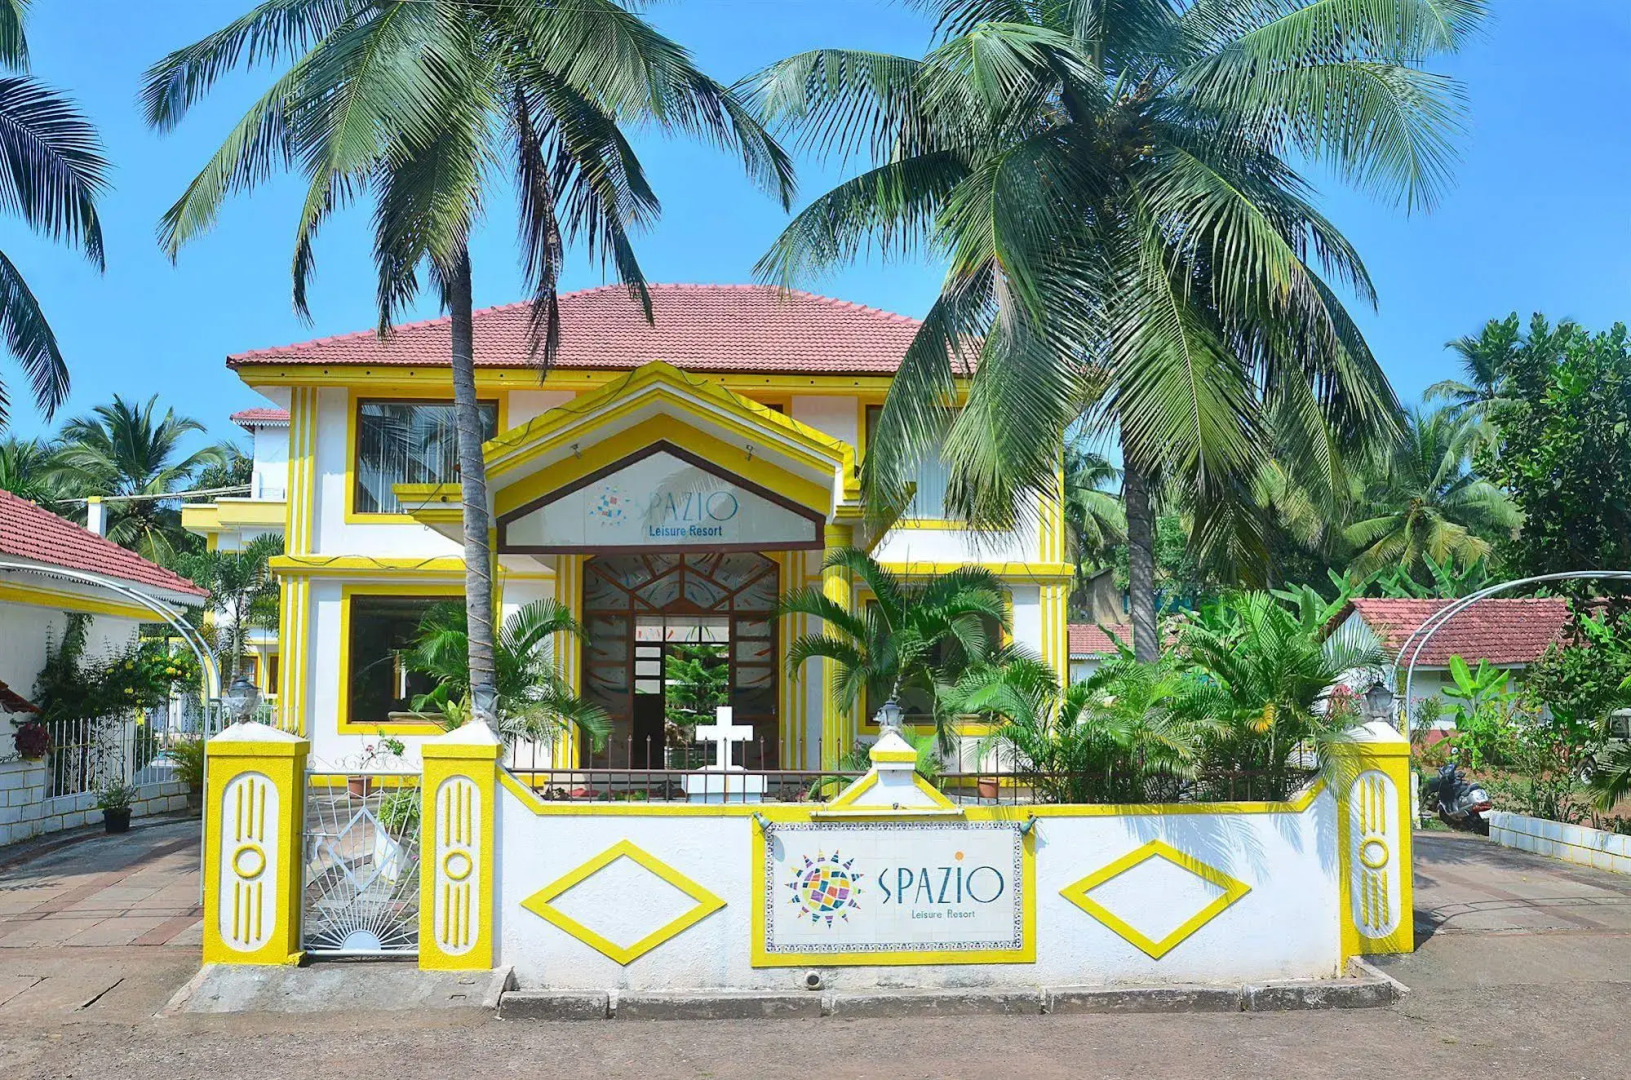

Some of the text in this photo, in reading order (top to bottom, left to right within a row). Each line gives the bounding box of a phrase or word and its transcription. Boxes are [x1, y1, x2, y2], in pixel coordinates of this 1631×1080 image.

[649, 525, 723, 537] Leisure Resort
[878, 851, 1005, 904] SPAZIO
[911, 908, 976, 919] Leisure Resort
